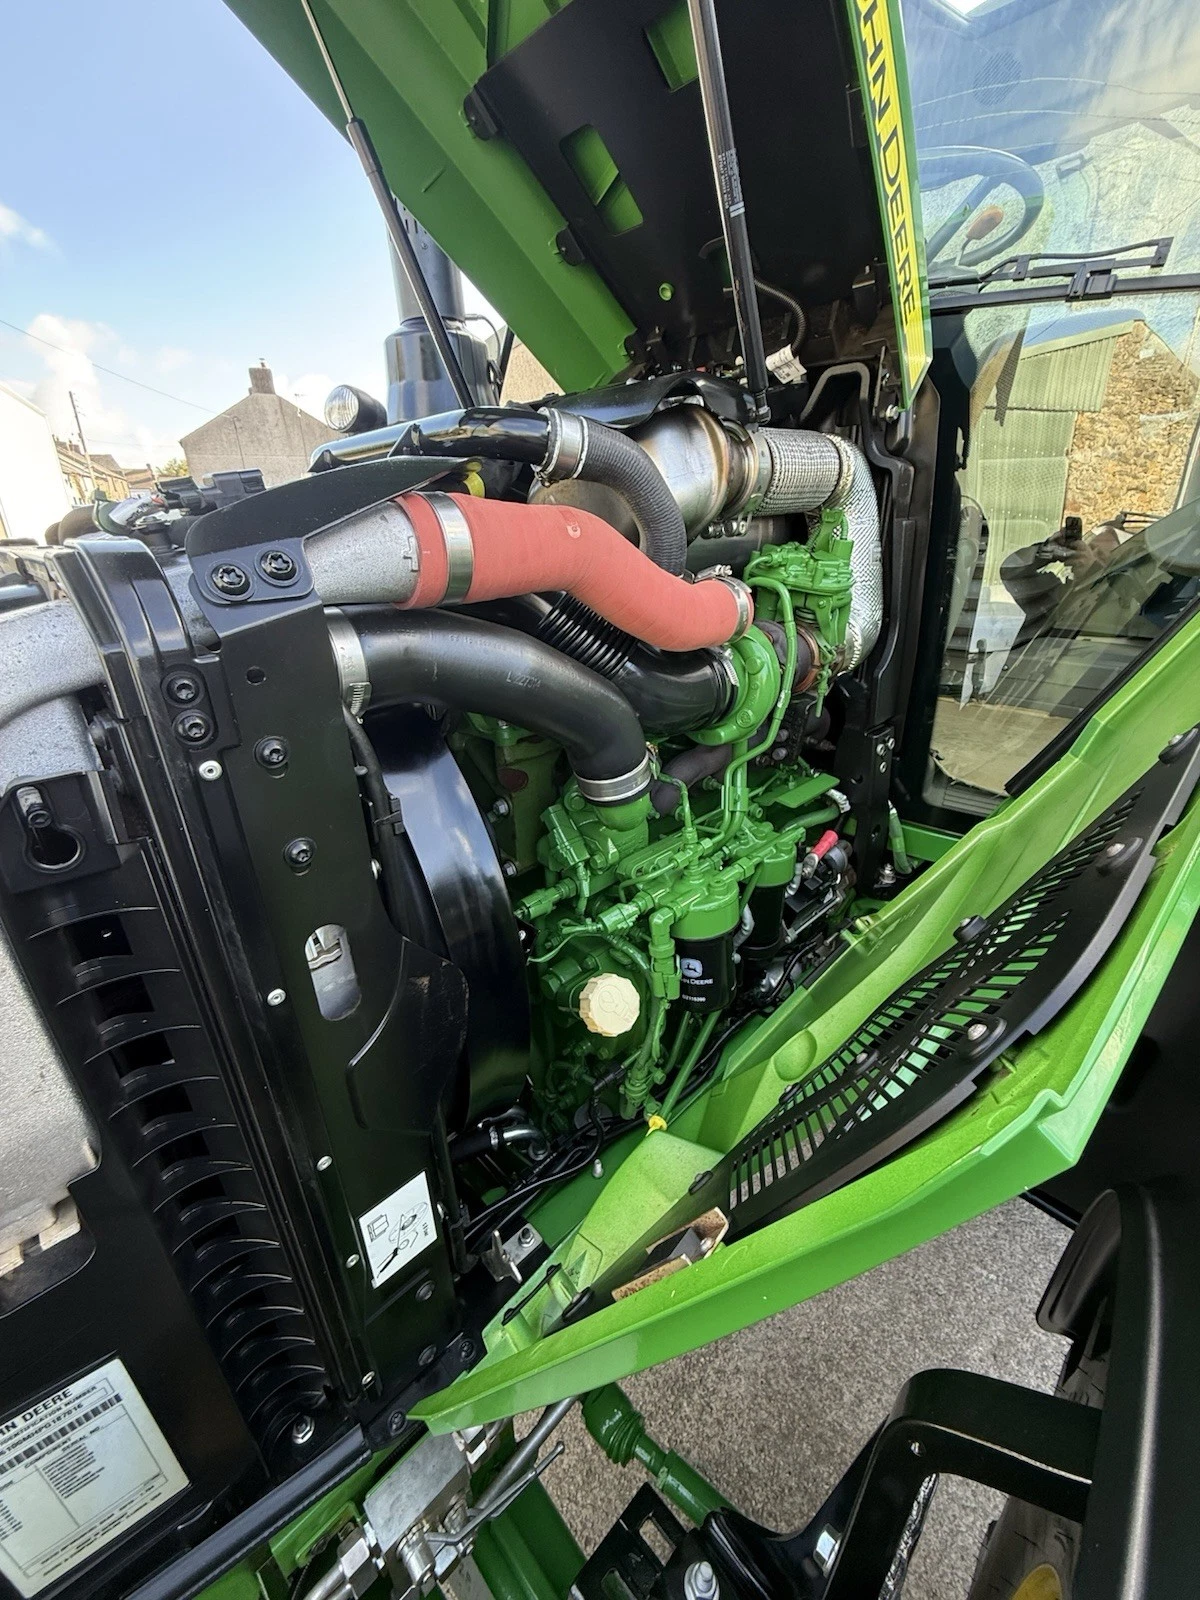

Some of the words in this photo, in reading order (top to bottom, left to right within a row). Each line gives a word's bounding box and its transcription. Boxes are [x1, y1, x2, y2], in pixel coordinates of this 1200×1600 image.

[862, 0, 891, 124] HN
[882, 125, 915, 325] DEERE
[690, 978, 714, 986] DEERE
[22, 1388, 74, 1423] DEERE
[64, 1385, 98, 1408] NUMBER
[24, 1437, 72, 1469] COMPONENT
[61, 1435, 88, 1453] SERIAL
